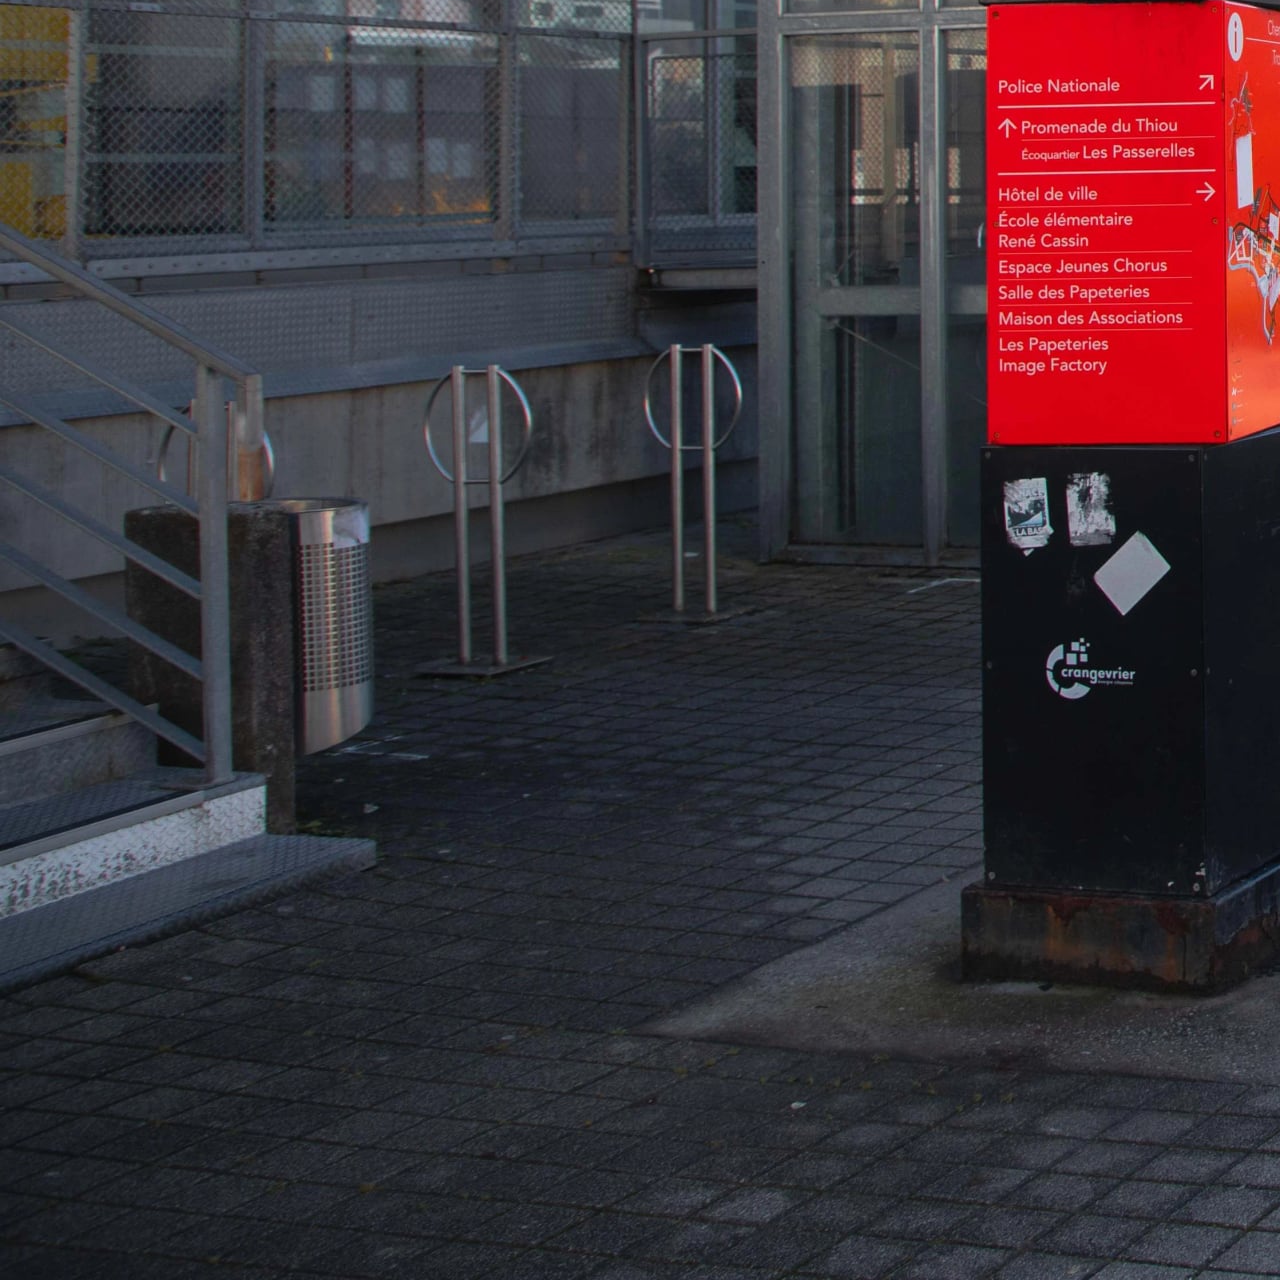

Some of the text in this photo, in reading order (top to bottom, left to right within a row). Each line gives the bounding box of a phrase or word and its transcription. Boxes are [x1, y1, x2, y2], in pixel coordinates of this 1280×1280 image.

[998, 78, 1121, 94] Police Nationale
[1021, 118, 1178, 135] Promenade du Thiou
[1021, 144, 1195, 162] Écoquartier Les Passerelles
[998, 186, 1098, 202] Hôtel de ville
[998, 210, 1133, 227] École élémentaire
[998, 233, 1089, 248] René Cassin
[998, 258, 1168, 276] Espace Jeunes Chorus
[998, 284, 1150, 302] Salle des Papeteries
[999, 310, 1183, 326] Maison des Associations
[999, 336, 1109, 355] Les Papeteries
[999, 358, 1107, 376] Image Factory
[1061, 666, 1136, 684] crangevrier
